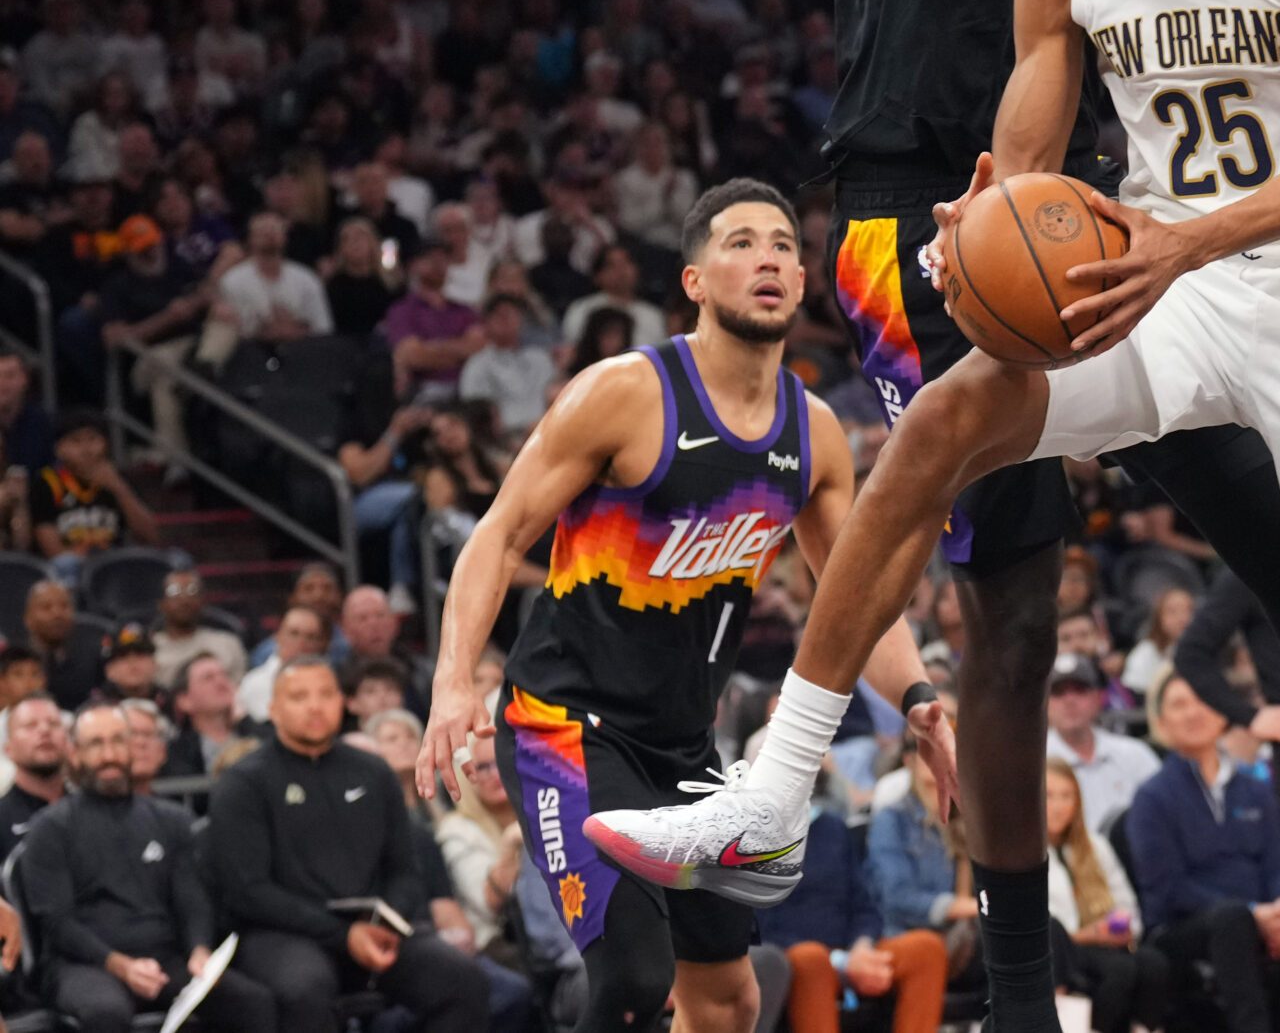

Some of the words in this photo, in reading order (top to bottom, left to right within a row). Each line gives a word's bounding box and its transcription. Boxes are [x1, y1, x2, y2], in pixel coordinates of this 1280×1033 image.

[1151, 78, 1276, 200] 25
[768, 450, 800, 472] PayPal
[708, 602, 734, 663] 1
[537, 787, 567, 874] SUNS
